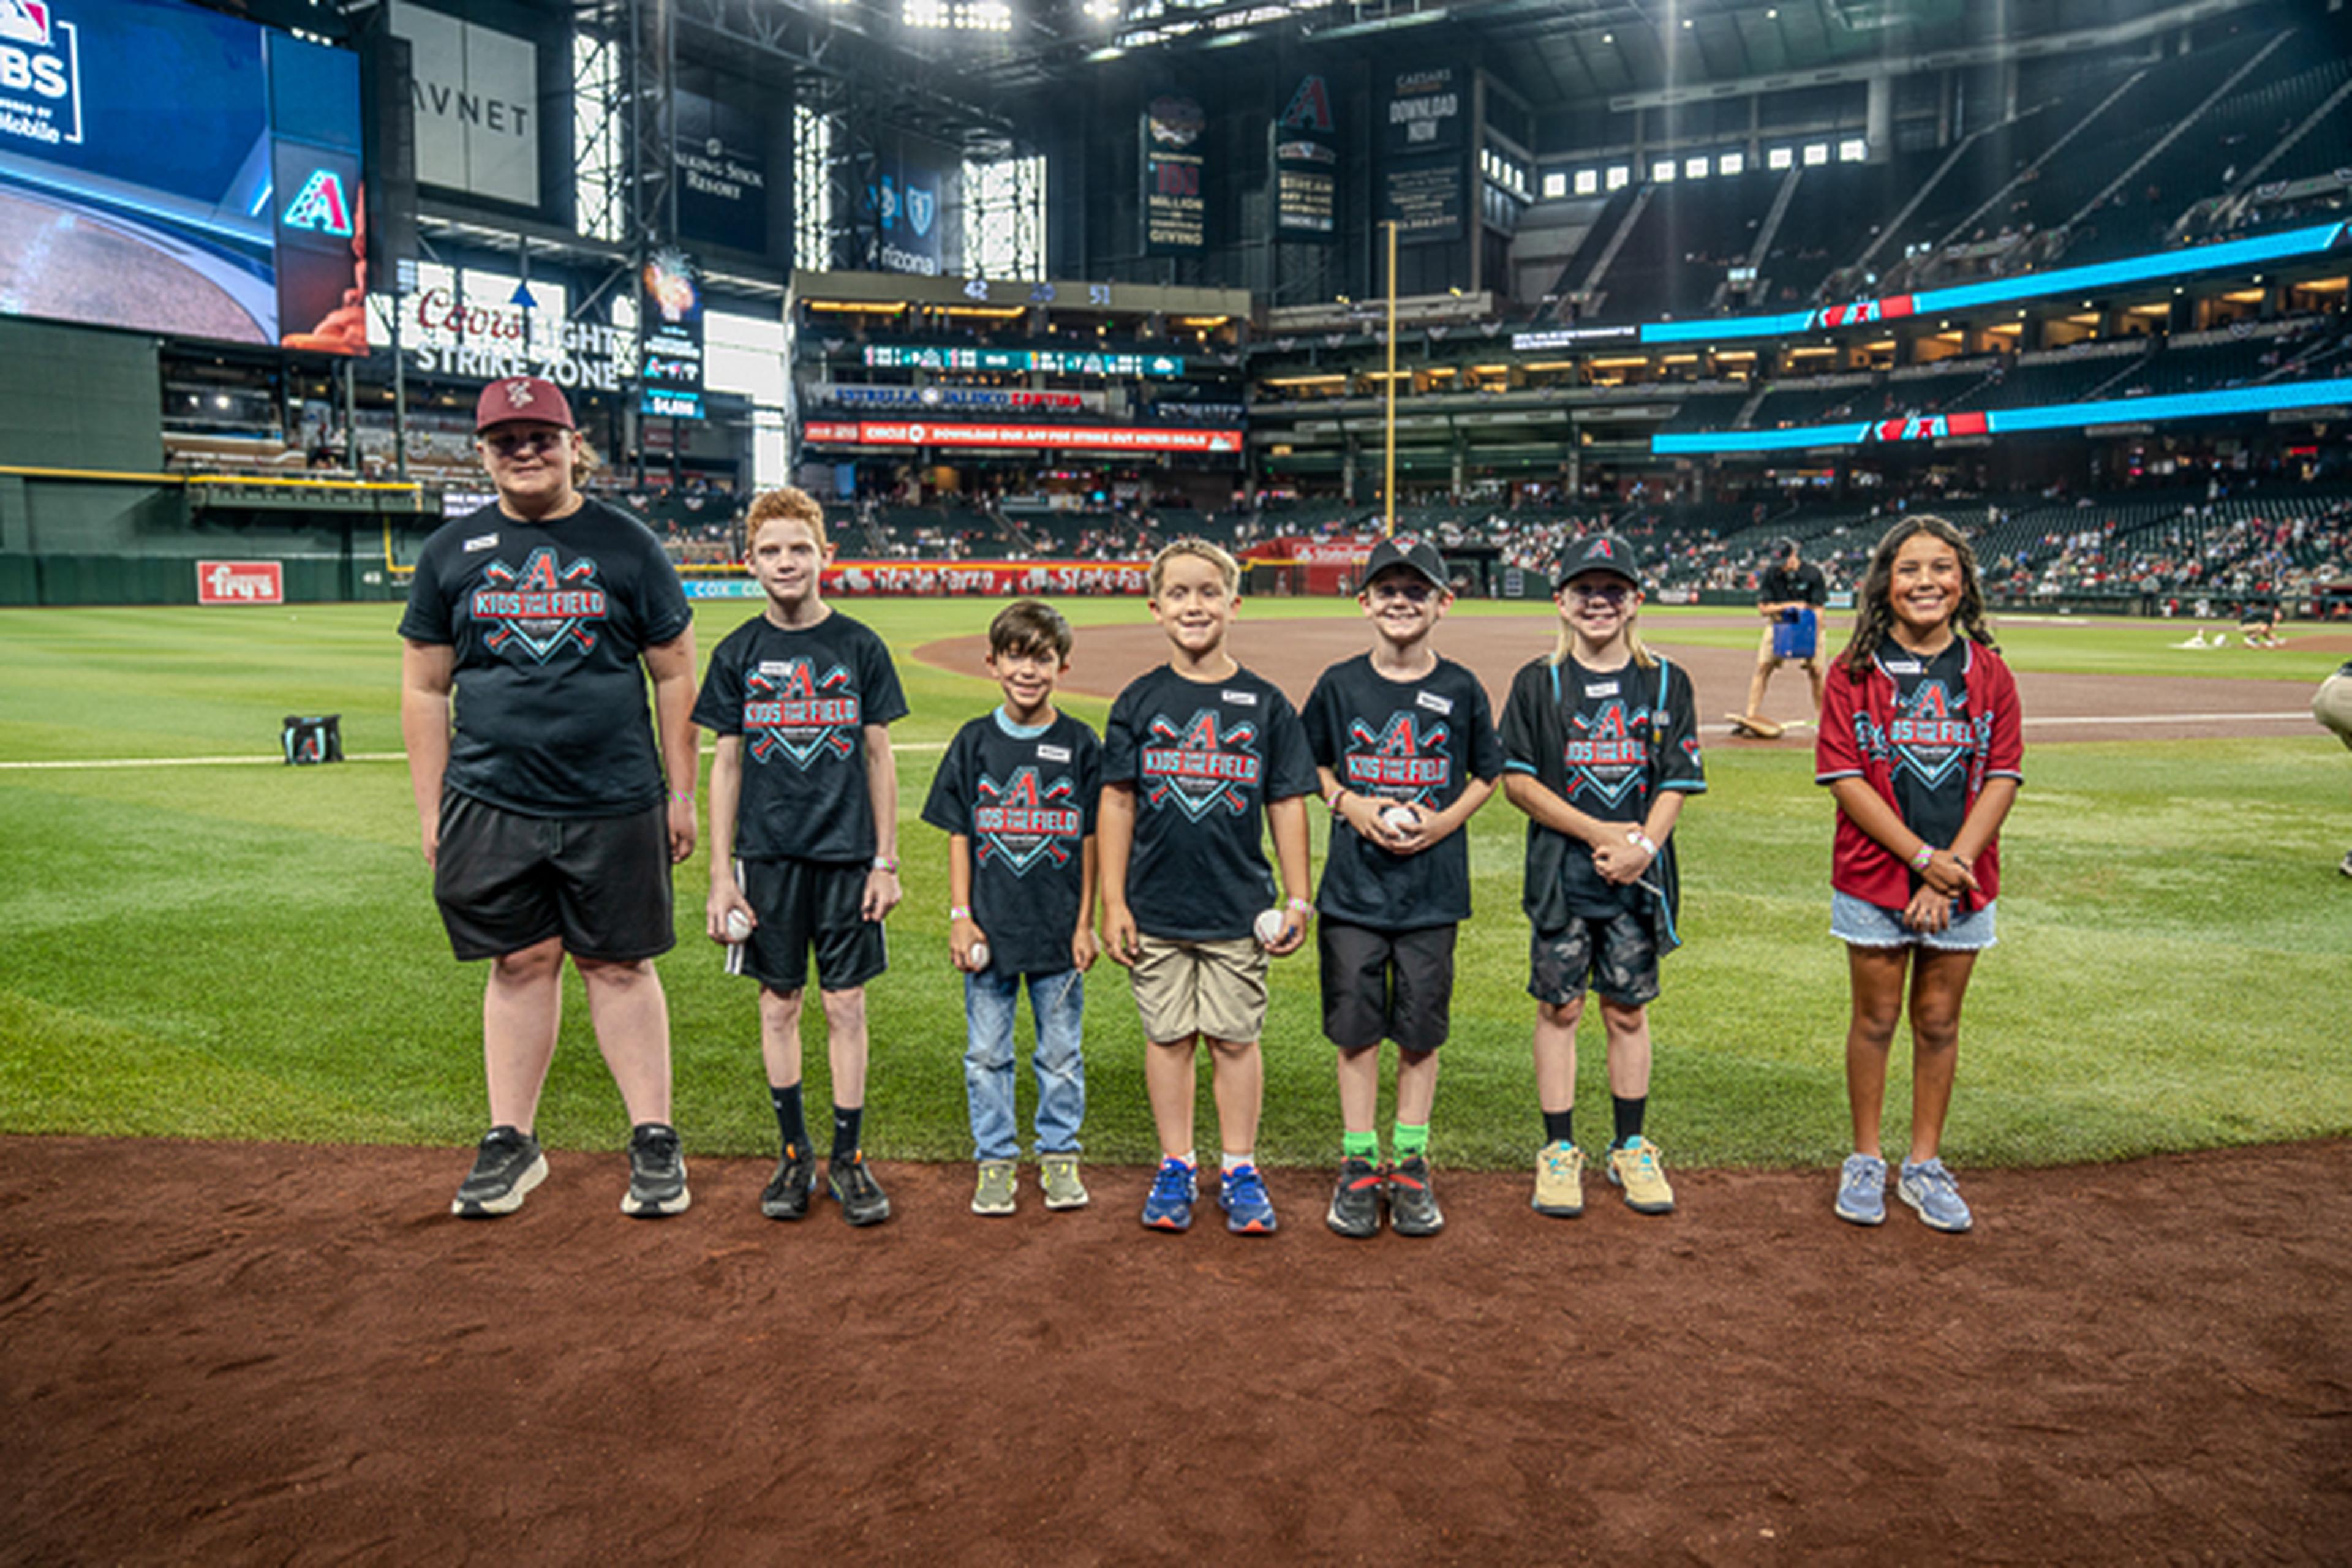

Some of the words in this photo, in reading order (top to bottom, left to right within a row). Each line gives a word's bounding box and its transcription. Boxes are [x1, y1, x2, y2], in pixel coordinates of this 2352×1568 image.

[1389, 93, 1458, 123] DOWNLOAD
[686, 170, 741, 200] RESORT
[1090, 285, 1110, 305] 51
[417, 343, 528, 378] STRIKE
[540, 349, 620, 391] ZONE
[941, 390, 1008, 405] JALISCO
[477, 593, 520, 614] KIDS
[552, 592, 605, 613] FIELD
[745, 703, 781, 723] KIDS
[810, 699, 856, 722] FIELD
[1144, 752, 1180, 771] KIDS
[1208, 755, 1256, 778] FIELD
[1032, 810, 1078, 832] FIELD
